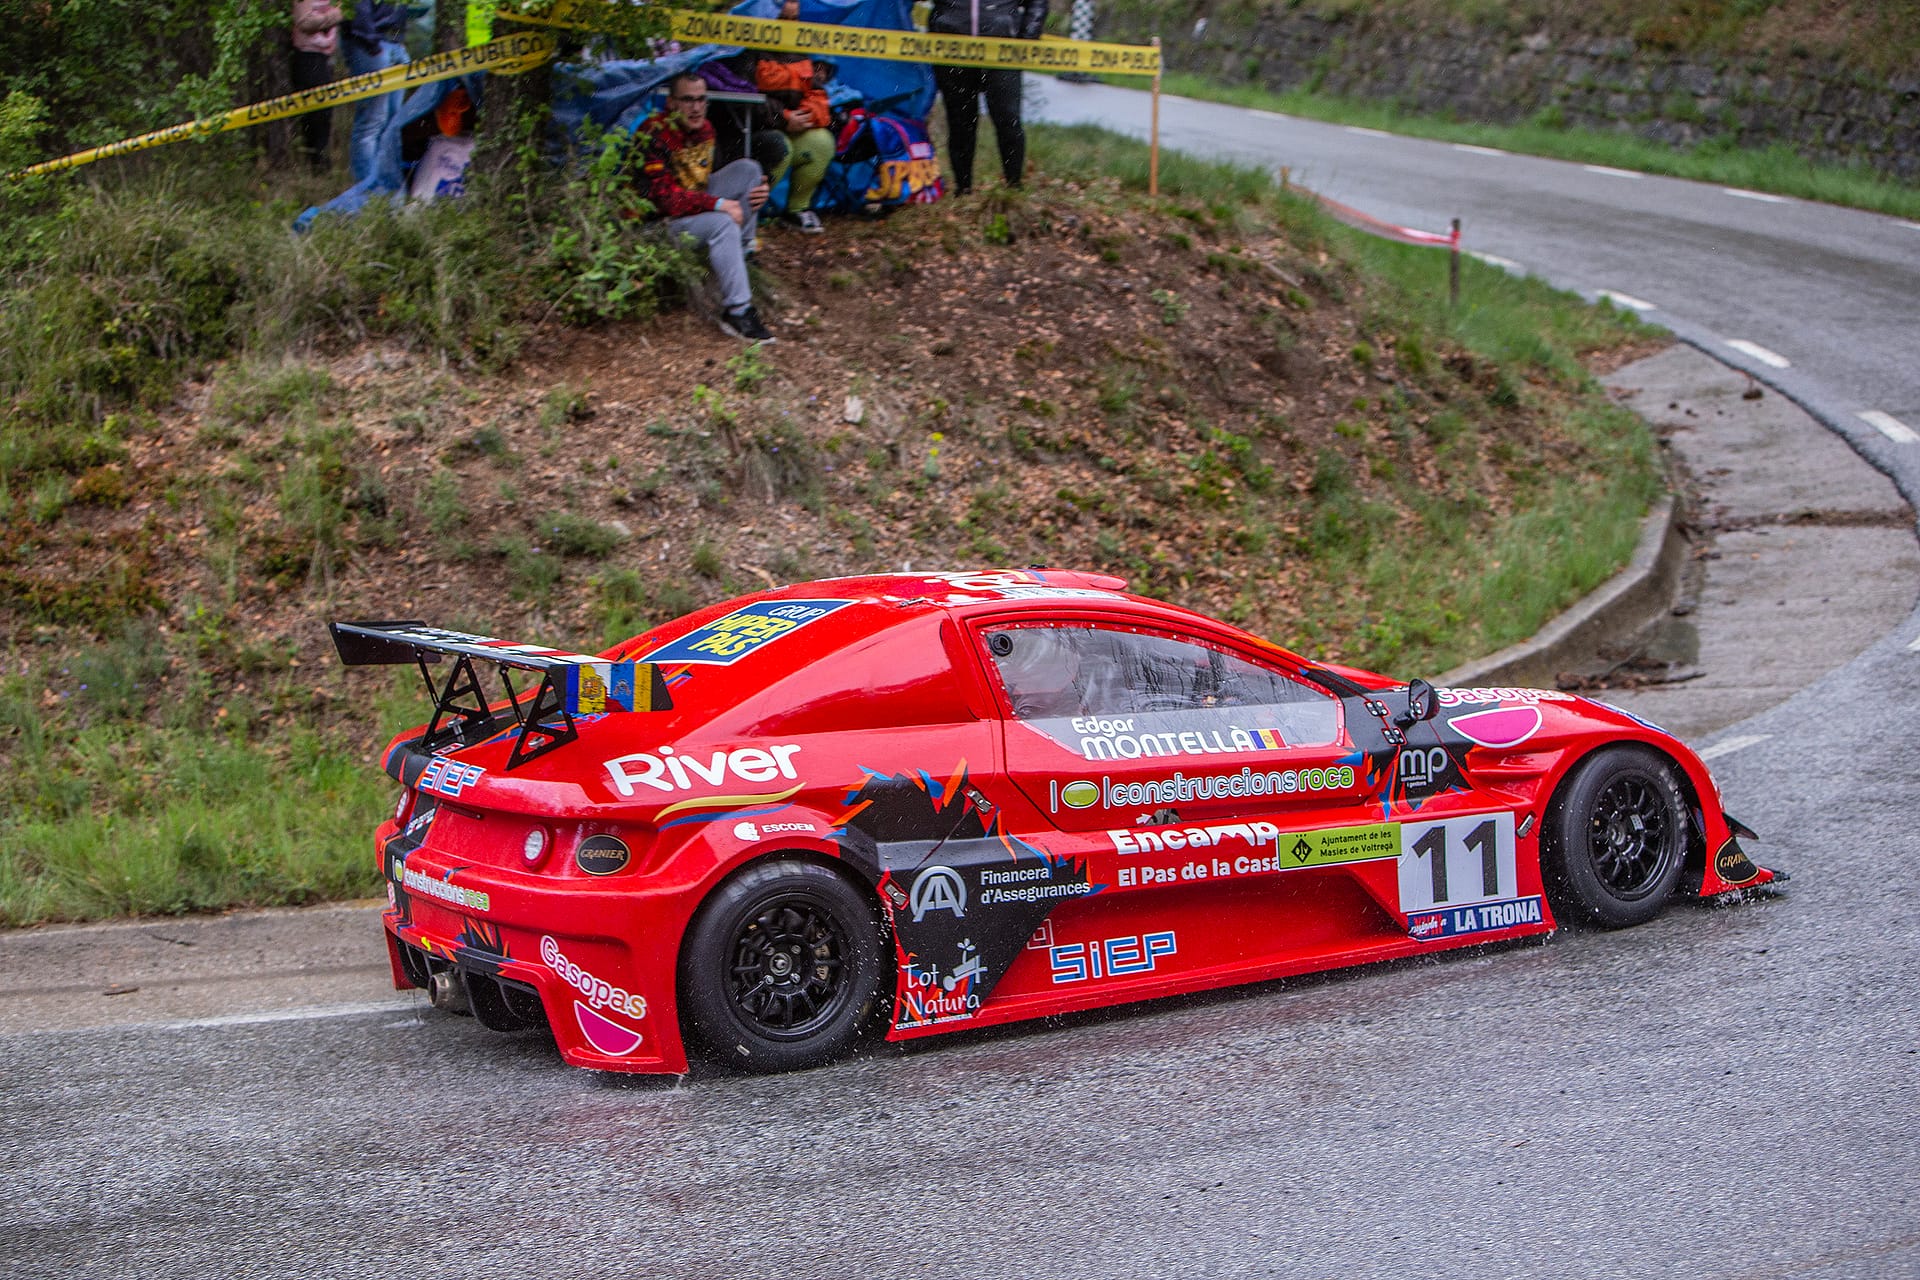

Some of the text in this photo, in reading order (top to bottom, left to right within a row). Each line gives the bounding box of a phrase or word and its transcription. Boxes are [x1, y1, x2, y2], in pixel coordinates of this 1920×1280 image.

[685, 16, 782, 45] ZONA PUBLICO
[796, 27, 887, 54] ZONA PUBLICO
[406, 36, 543, 80] ZONA PUBLICO
[900, 36, 985, 61] ZONA PUBLICO
[998, 43, 1079, 66] ZONA PUBLICO
[1090, 50, 1118, 67] ZONA
[247, 72, 383, 120] ZONA PUBLICO
[767, 604, 826, 619] GRUP
[703, 613, 797, 639] HIPER
[687, 631, 762, 656] PAS
[1070, 716, 1135, 739] Edgar
[1080, 725, 1255, 761] MONTELLÀ
[602, 744, 802, 797] River
[1400, 747, 1448, 783] mp
[1110, 765, 1354, 808] construccionsroca
[1107, 820, 1279, 855] Encamp
[1321, 830, 1392, 847] Ajuntament de les
[580, 848, 625, 861] GRANIER
[1320, 847, 1348, 857] Masies
[1350, 846, 1360, 854] de
[1411, 820, 1499, 904] 11
[980, 867, 1050, 886] Financera
[1118, 855, 1279, 887] El Pas de la Casa
[981, 882, 1091, 904] d'Assegurances
[1454, 909, 1478, 933] LA
[1479, 899, 1542, 928] TRONA
[540, 934, 648, 1020] Gasopas
[900, 963, 940, 989] Tot
[903, 990, 981, 1022] Natura
